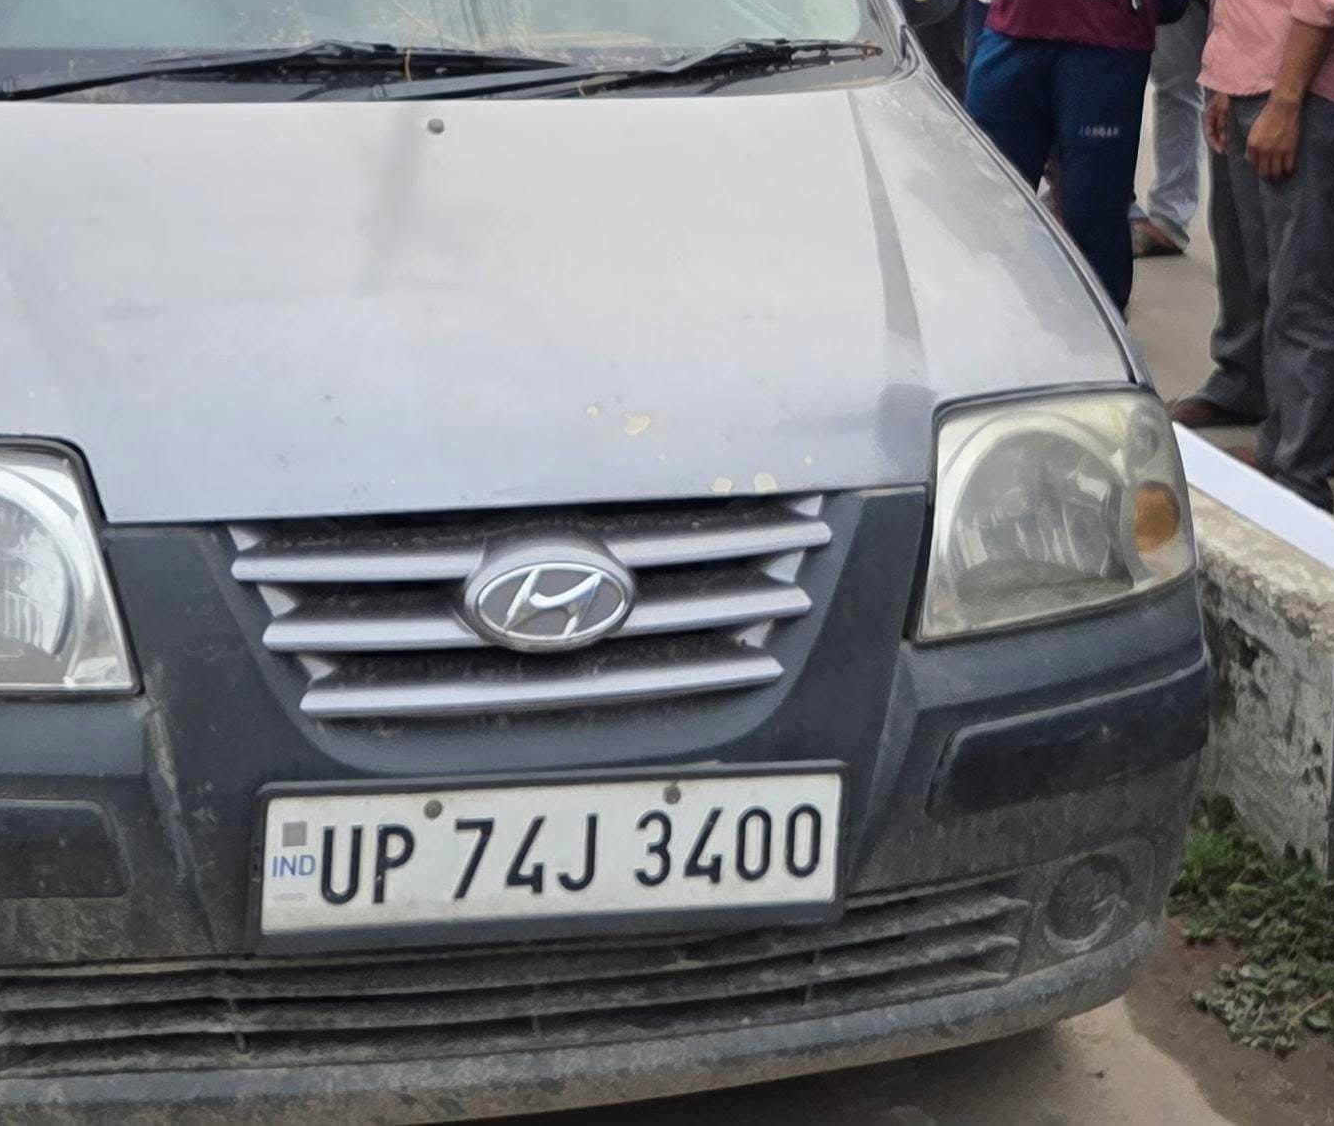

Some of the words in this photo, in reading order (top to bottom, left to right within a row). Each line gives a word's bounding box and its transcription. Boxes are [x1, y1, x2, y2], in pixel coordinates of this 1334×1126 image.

[272, 855, 316, 877] IND
[320, 823, 415, 905] UP
[453, 813, 599, 901] 74J
[633, 802, 824, 888] 3400
